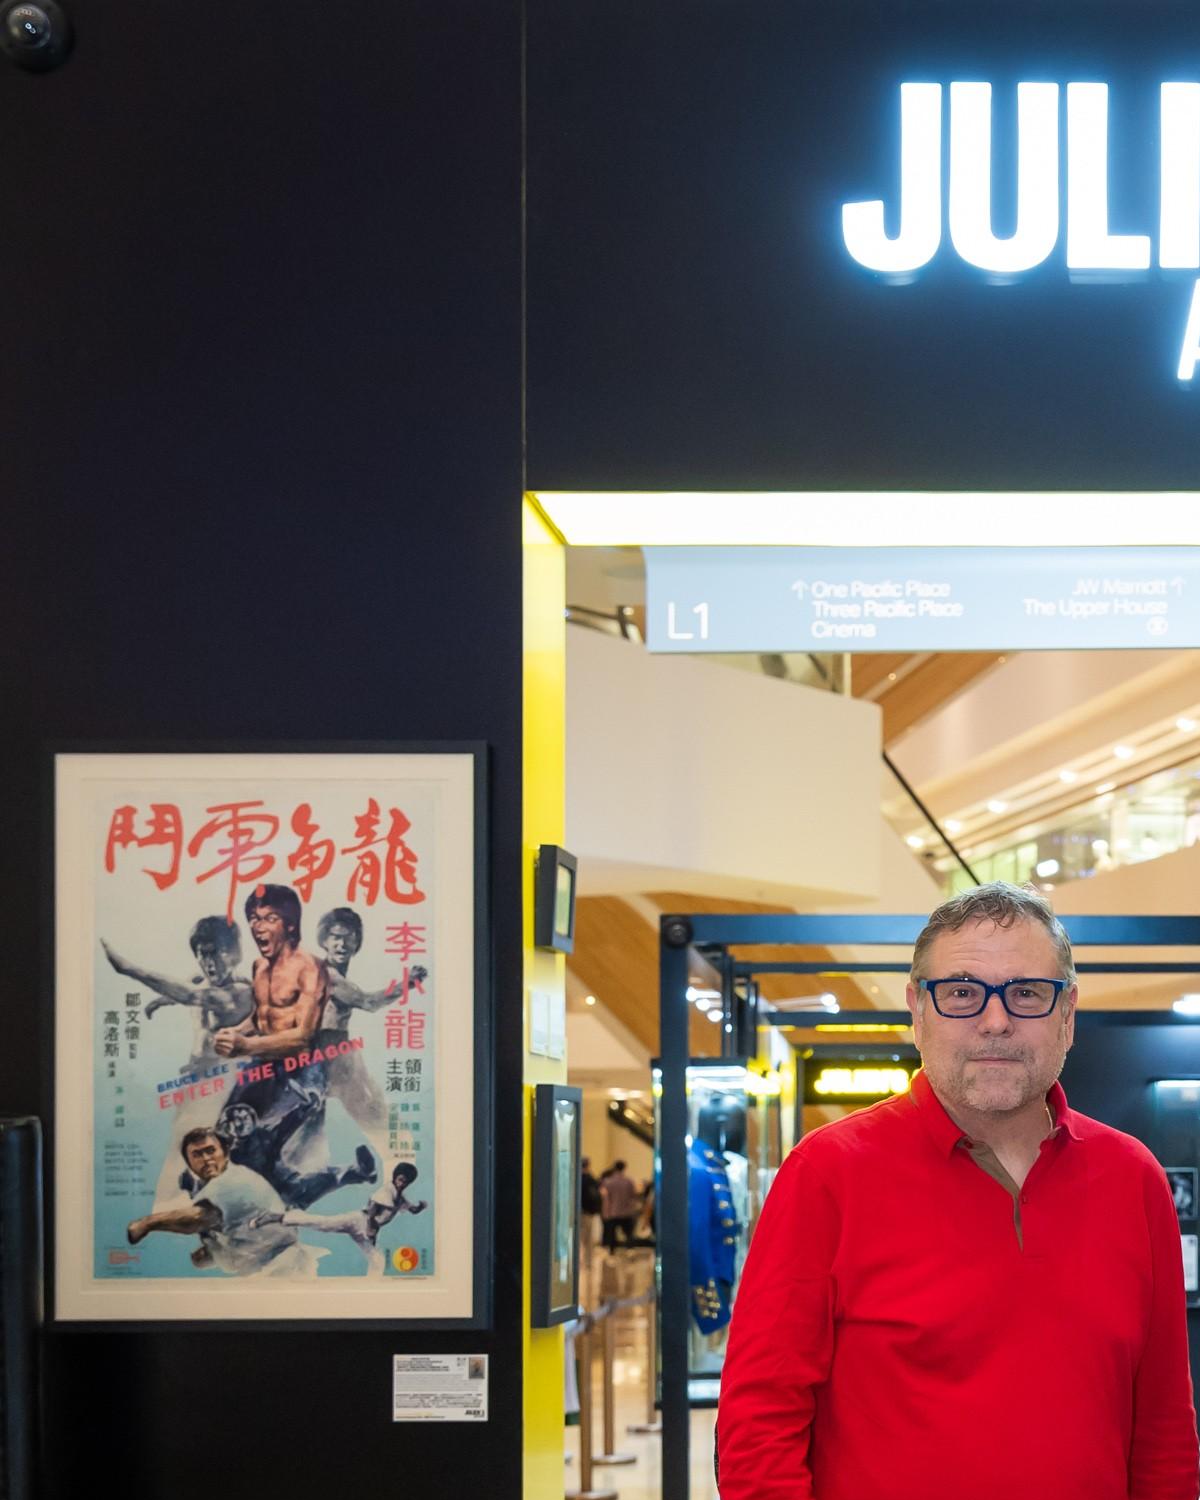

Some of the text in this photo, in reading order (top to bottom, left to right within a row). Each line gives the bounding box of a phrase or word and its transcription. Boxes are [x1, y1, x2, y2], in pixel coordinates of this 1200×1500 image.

[811, 581, 951, 599] One Pacific Place
[1072, 579, 1100, 595] JW
[812, 600, 964, 618] Three Pacific Place
[1024, 599, 1168, 619] The Upper House
[667, 602, 708, 640] L1
[811, 620, 877, 638] Cinema
[385, 921, 427, 1050] 李小龍
[157, 1072, 199, 1094] BRUCE
[203, 1063, 230, 1077] LEE
[158, 1077, 226, 1110] ENTER
[235, 1062, 275, 1086] THE
[284, 1036, 365, 1073] DRAGON
